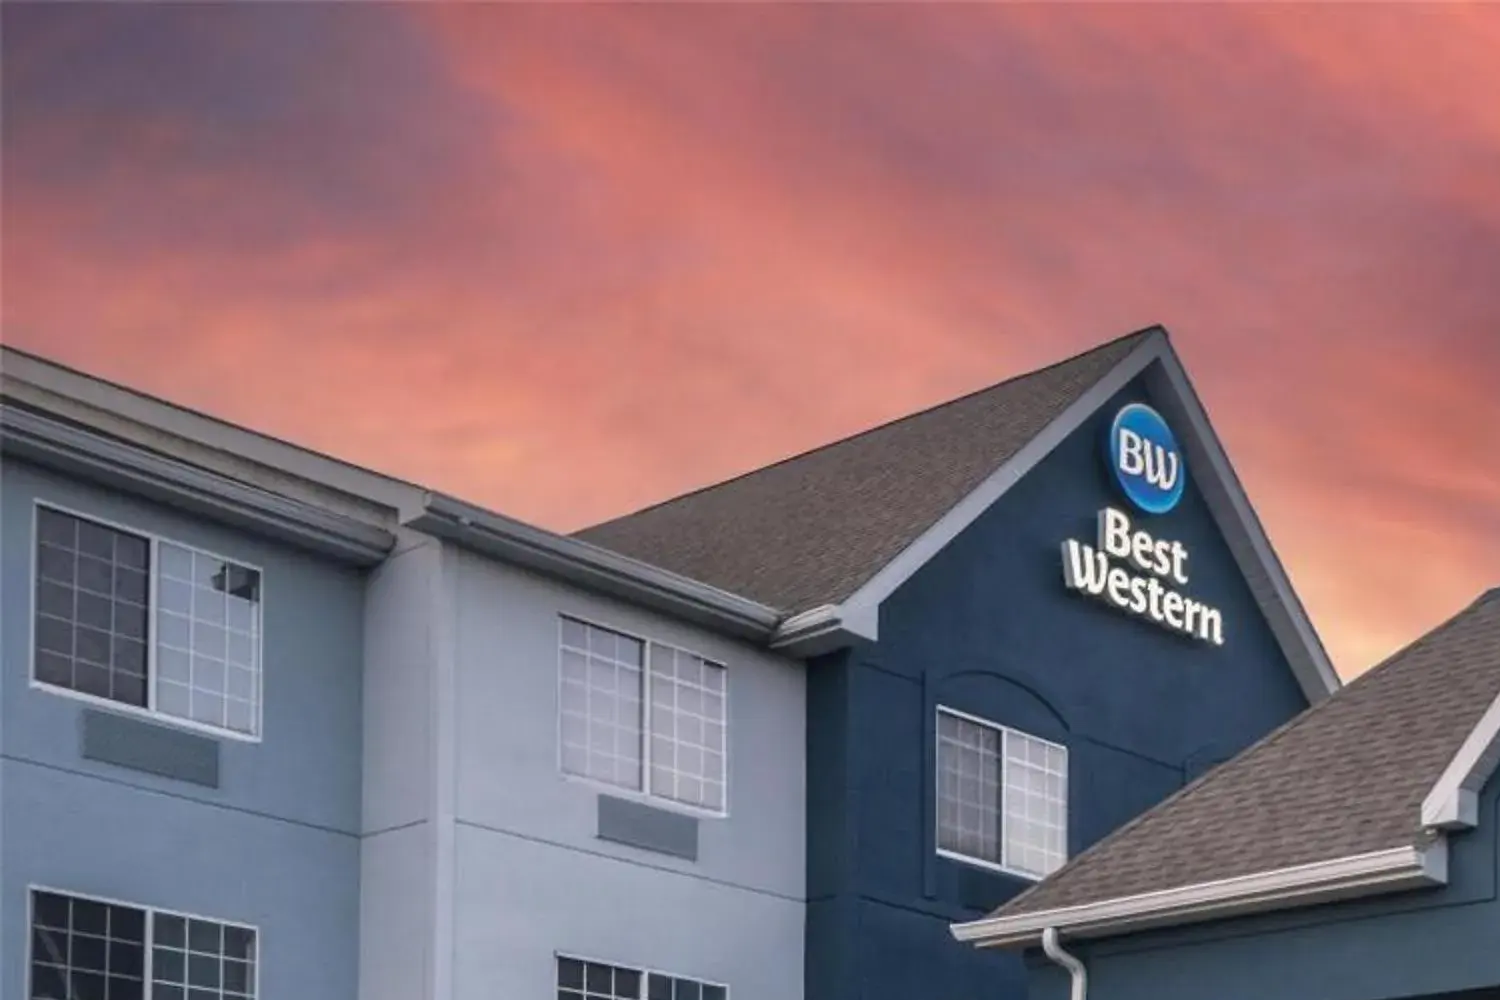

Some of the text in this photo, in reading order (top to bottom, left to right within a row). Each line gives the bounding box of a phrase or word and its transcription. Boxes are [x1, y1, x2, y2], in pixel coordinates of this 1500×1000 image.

[1119, 428, 1177, 490] BW
[1101, 507, 1188, 584] Best
[1064, 538, 1224, 645] Western
